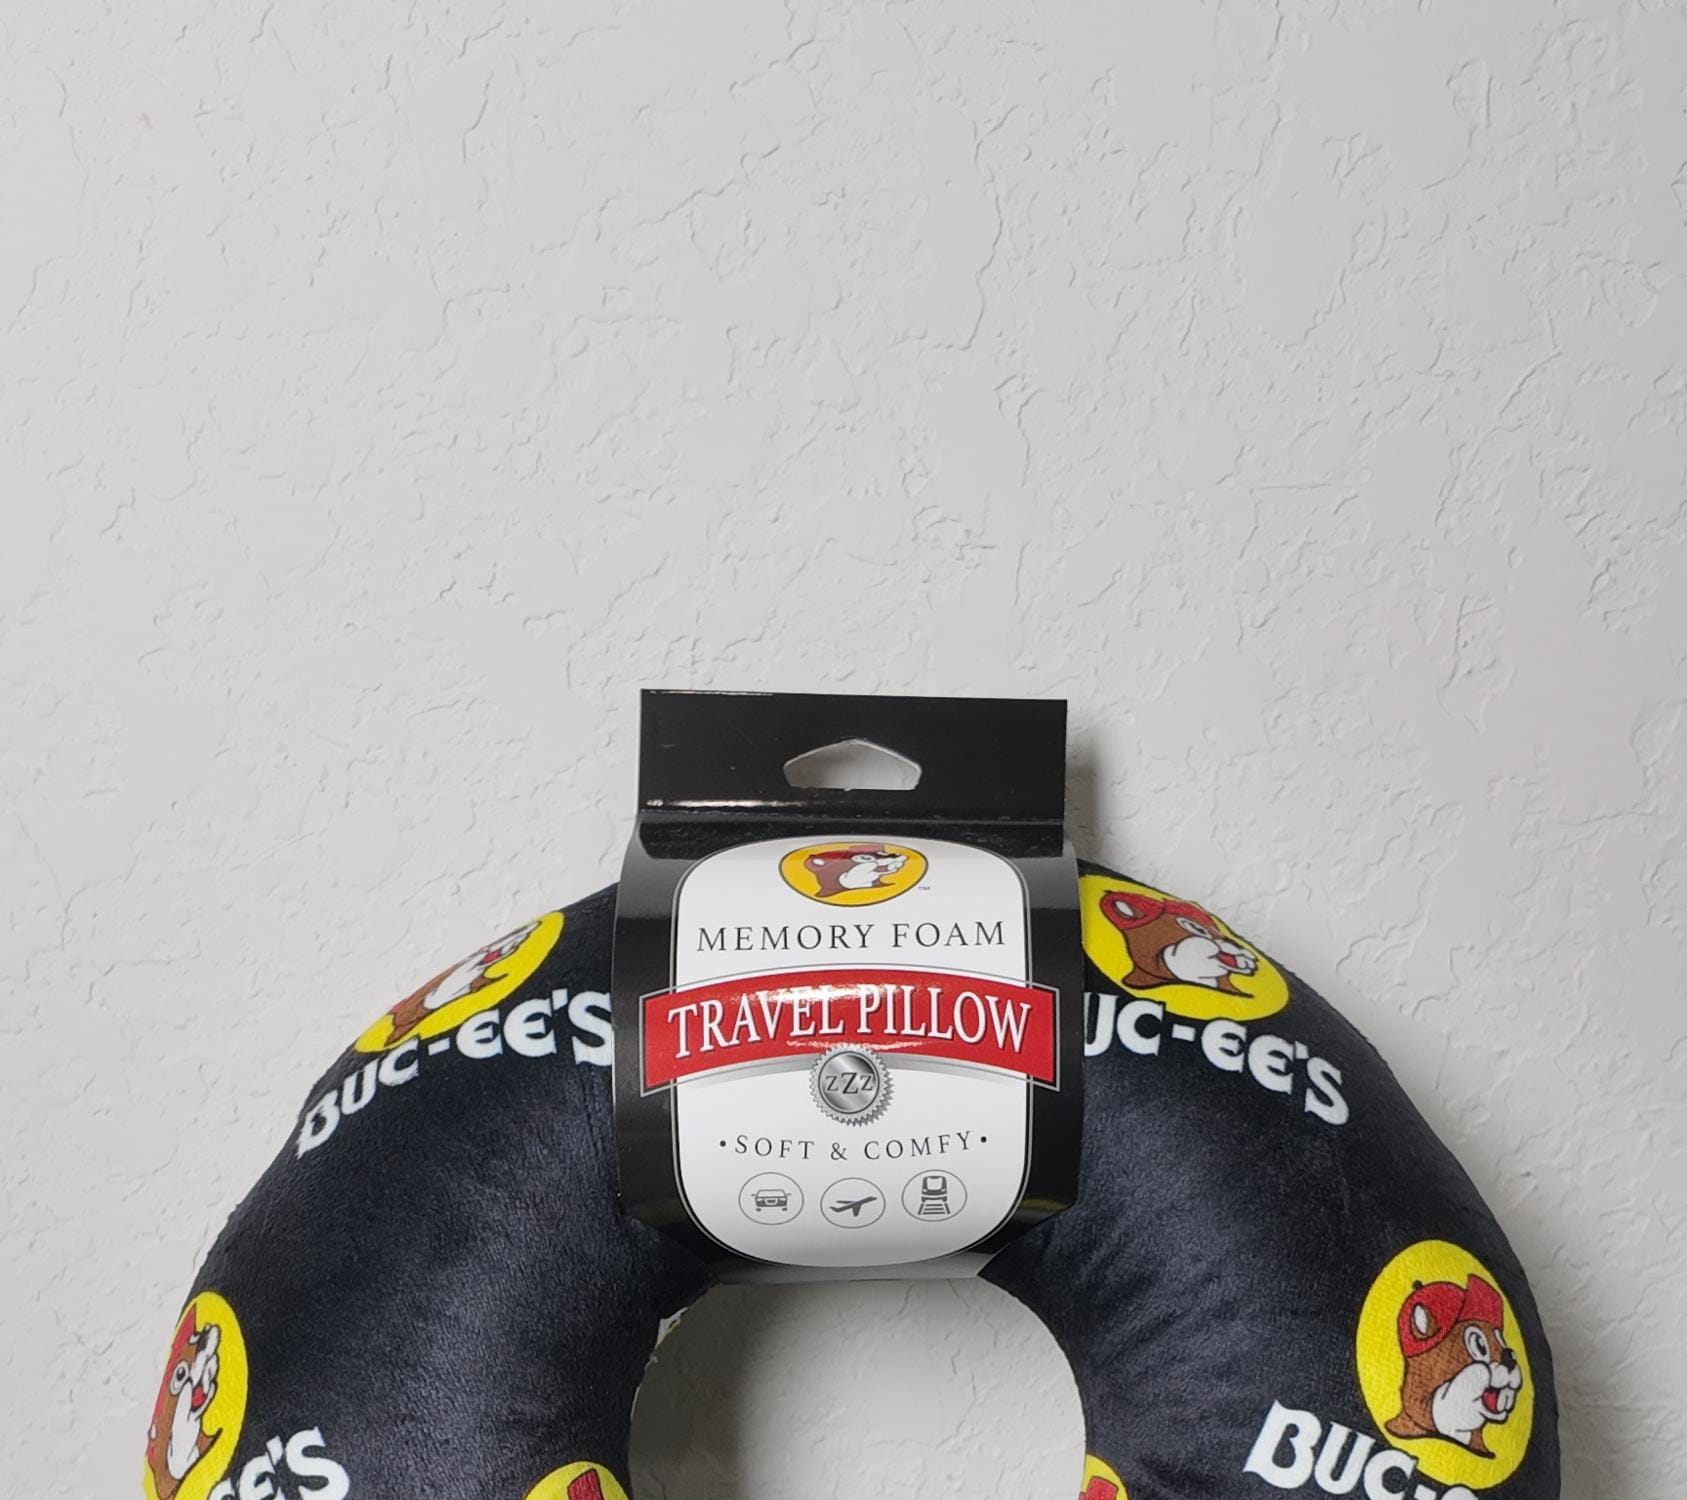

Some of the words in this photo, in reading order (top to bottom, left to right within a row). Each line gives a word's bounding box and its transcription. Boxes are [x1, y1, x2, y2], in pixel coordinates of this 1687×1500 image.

[696, 924, 876, 952] MEMORY
[892, 920, 1006, 948] FOAM
[667, 985, 845, 1059] TRAVEL
[856, 983, 1032, 1055] PILLOW
[1084, 991, 1350, 1126] UC-EE'S
[734, 1134, 815, 1160] SOFT
[830, 1142, 848, 1161] &
[863, 1130, 972, 1161] COMFY
